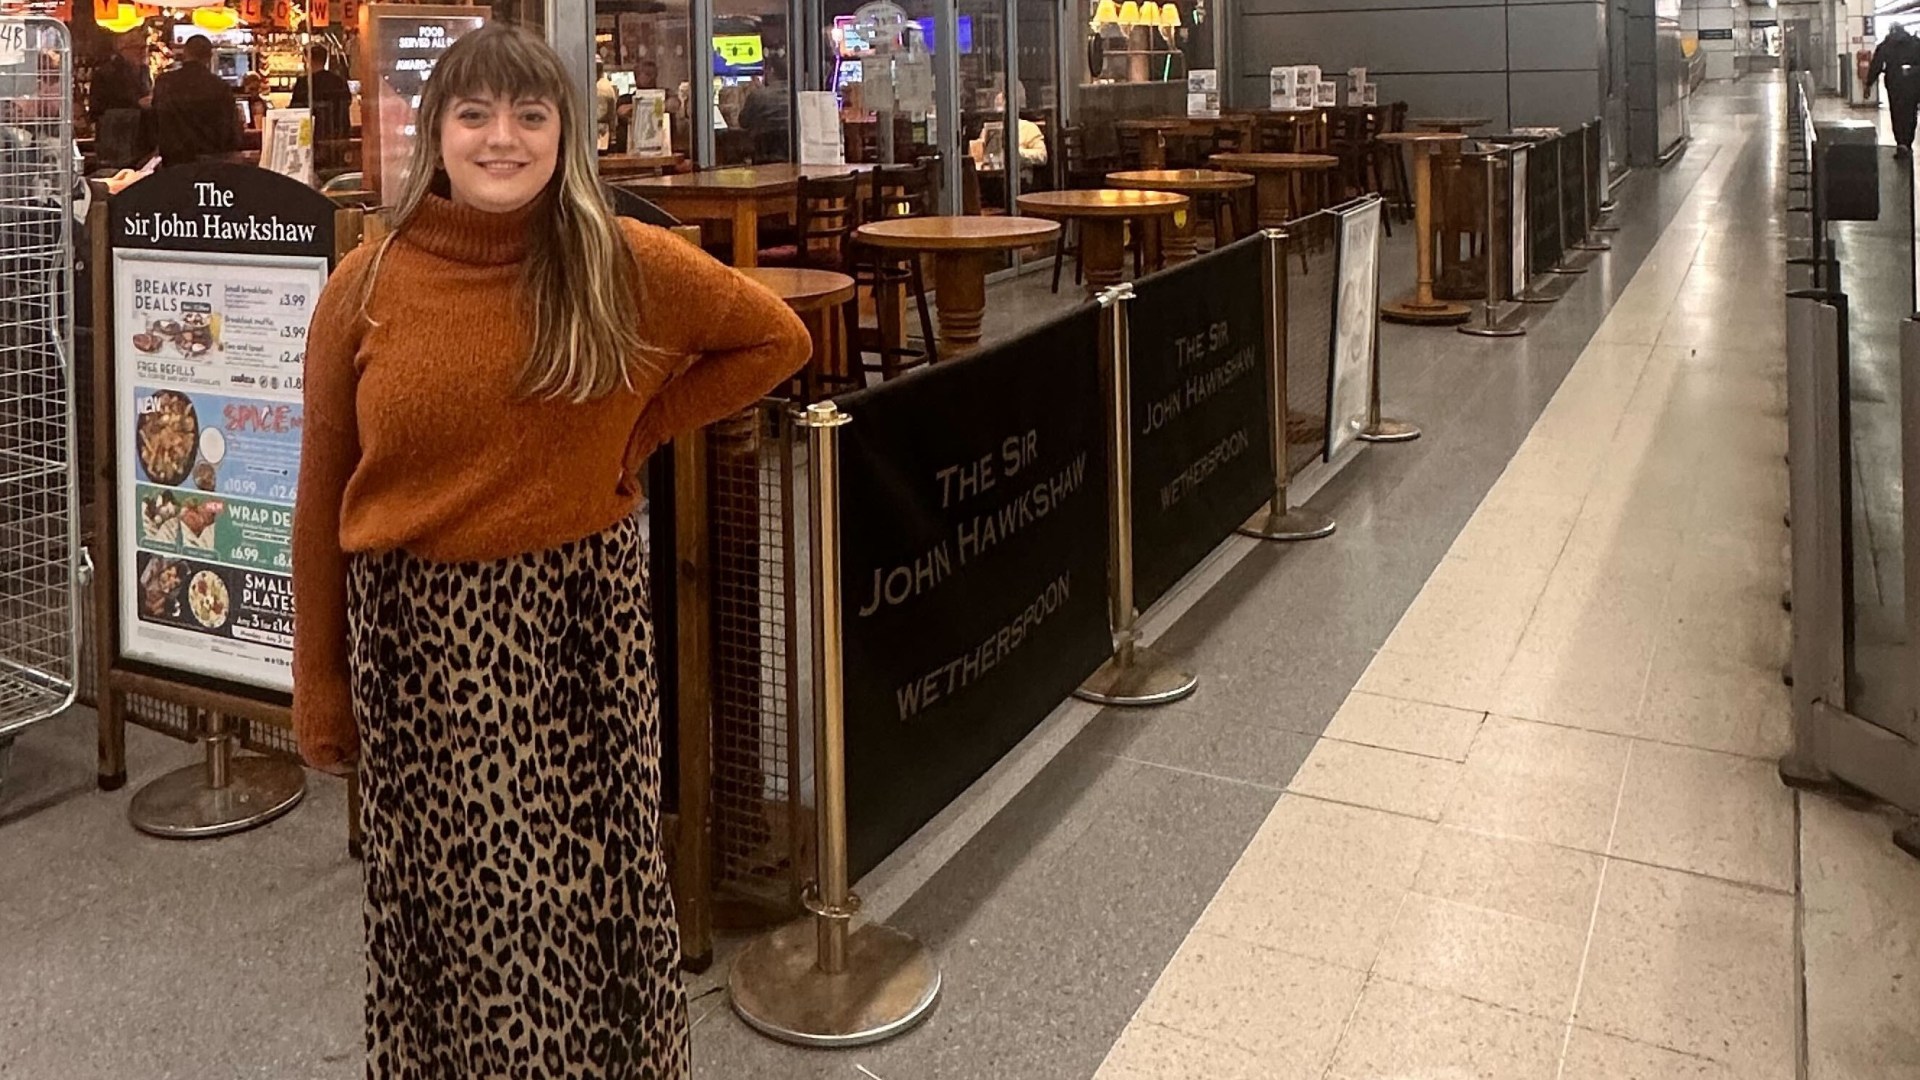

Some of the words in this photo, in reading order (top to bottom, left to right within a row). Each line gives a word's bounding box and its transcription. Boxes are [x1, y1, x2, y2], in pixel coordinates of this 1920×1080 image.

[194, 182, 234, 207] The
[125, 212, 150, 236] Sir
[151, 212, 198, 243] John
[203, 214, 316, 242] Hawkshaw
[135, 279, 213, 297] BREAKFAST
[135, 295, 178, 312] DEALS
[280, 294, 306, 307] £3.99
[280, 326, 306, 339] £3.99
[1175, 332, 1205, 368] THE
[1209, 321, 1230, 351] SIR
[137, 361, 158, 373] FREE
[160, 363, 196, 377] REFILLS
[284, 377, 303, 390] £1.8
[1142, 389, 1181, 435] JOHN
[936, 452, 997, 509] THE
[1002, 429, 1039, 477] SIR
[270, 484, 298, 501] £12.6
[228, 504, 269, 524] WRAP
[272, 510, 292, 528] DE
[858, 540, 951, 617] JOHN
[957, 452, 1088, 566] HAWKSHAW
[231, 546, 259, 562] £6.99
[245, 573, 295, 596] SMALL
[251, 613, 260, 628] 3
[896, 571, 1071, 722] WETHERSPOON
